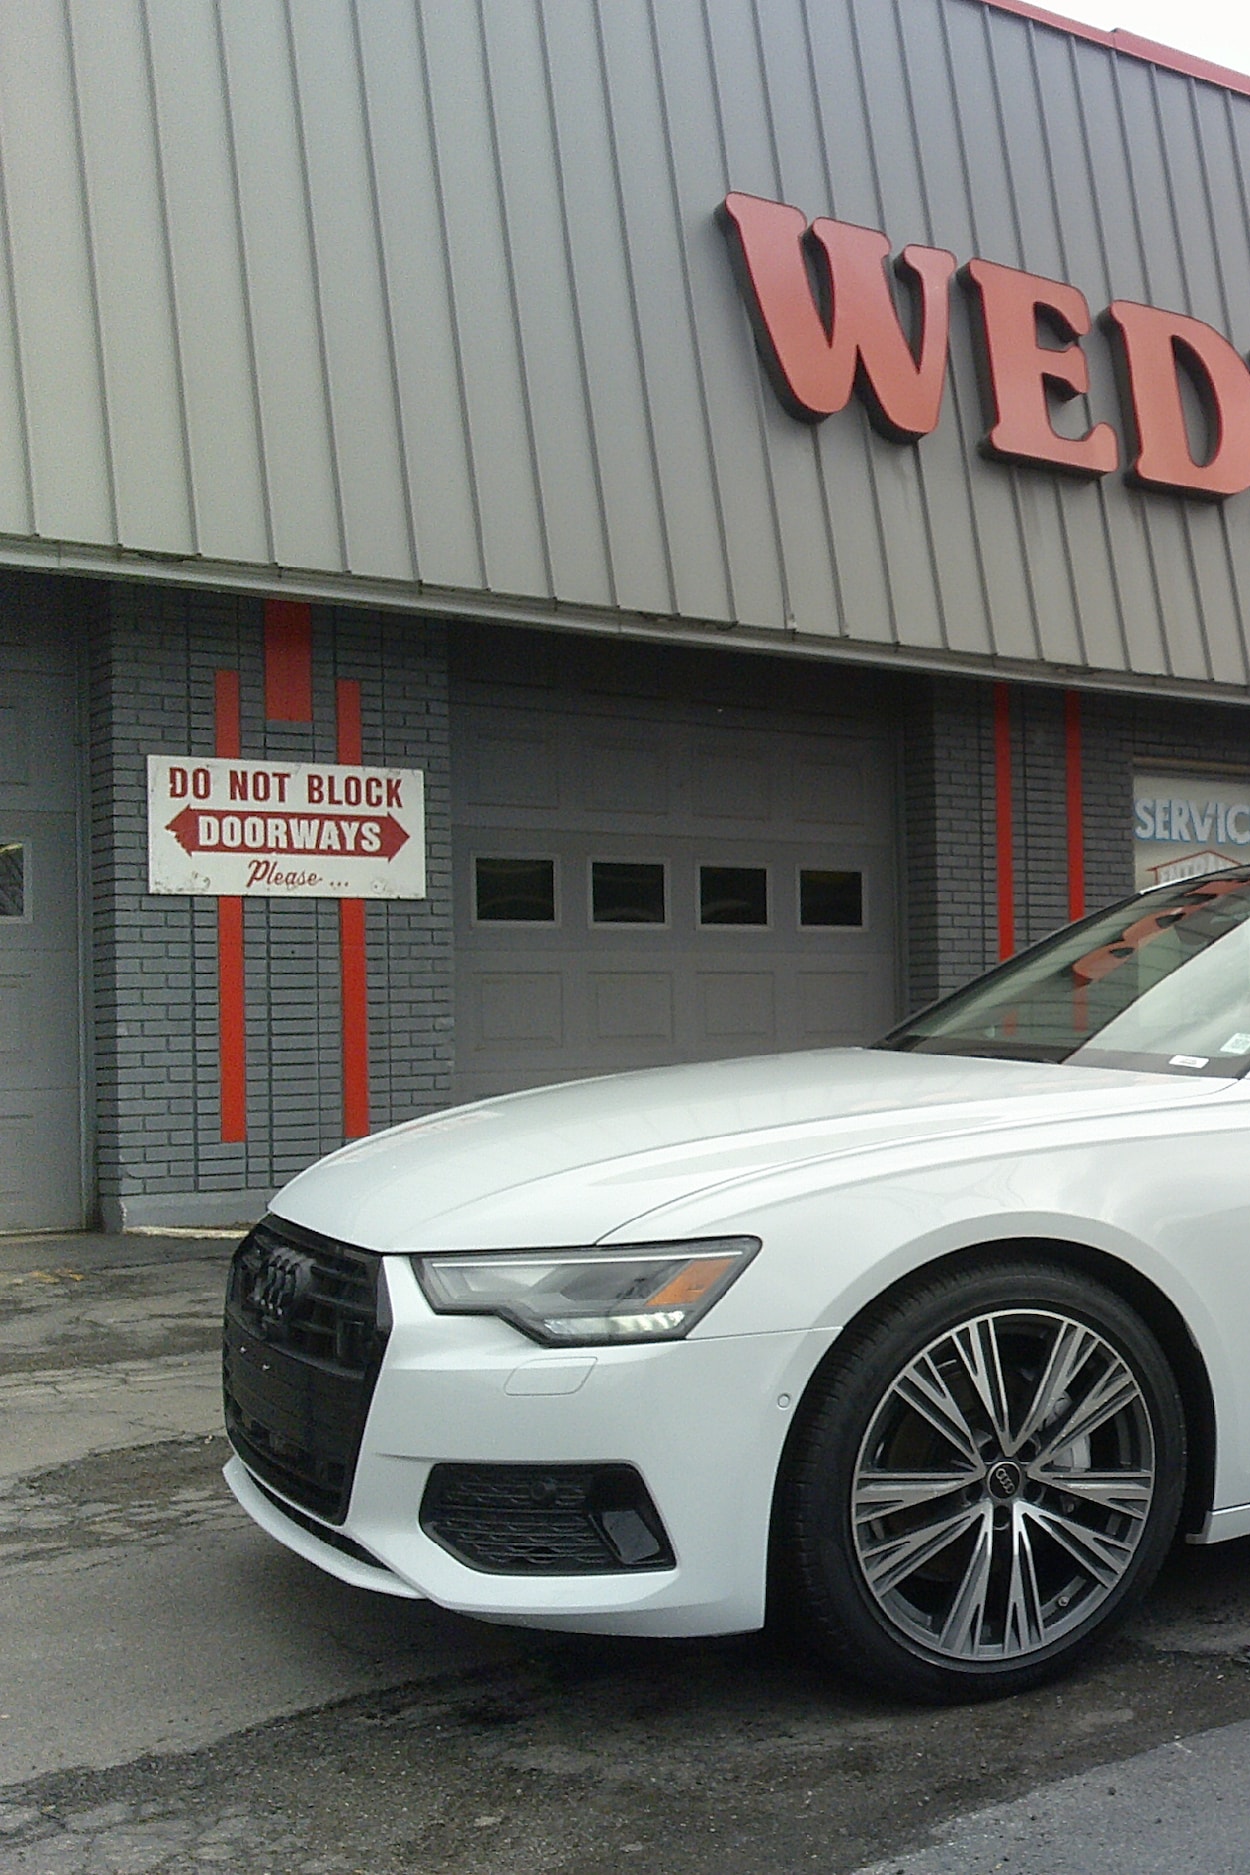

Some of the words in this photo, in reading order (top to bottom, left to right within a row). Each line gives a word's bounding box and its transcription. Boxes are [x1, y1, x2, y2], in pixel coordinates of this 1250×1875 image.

[169, 766, 212, 799] DO
[229, 770, 291, 803] NOT
[307, 774, 404, 808] BLOCK
[198, 815, 382, 853] DOORWAYS
